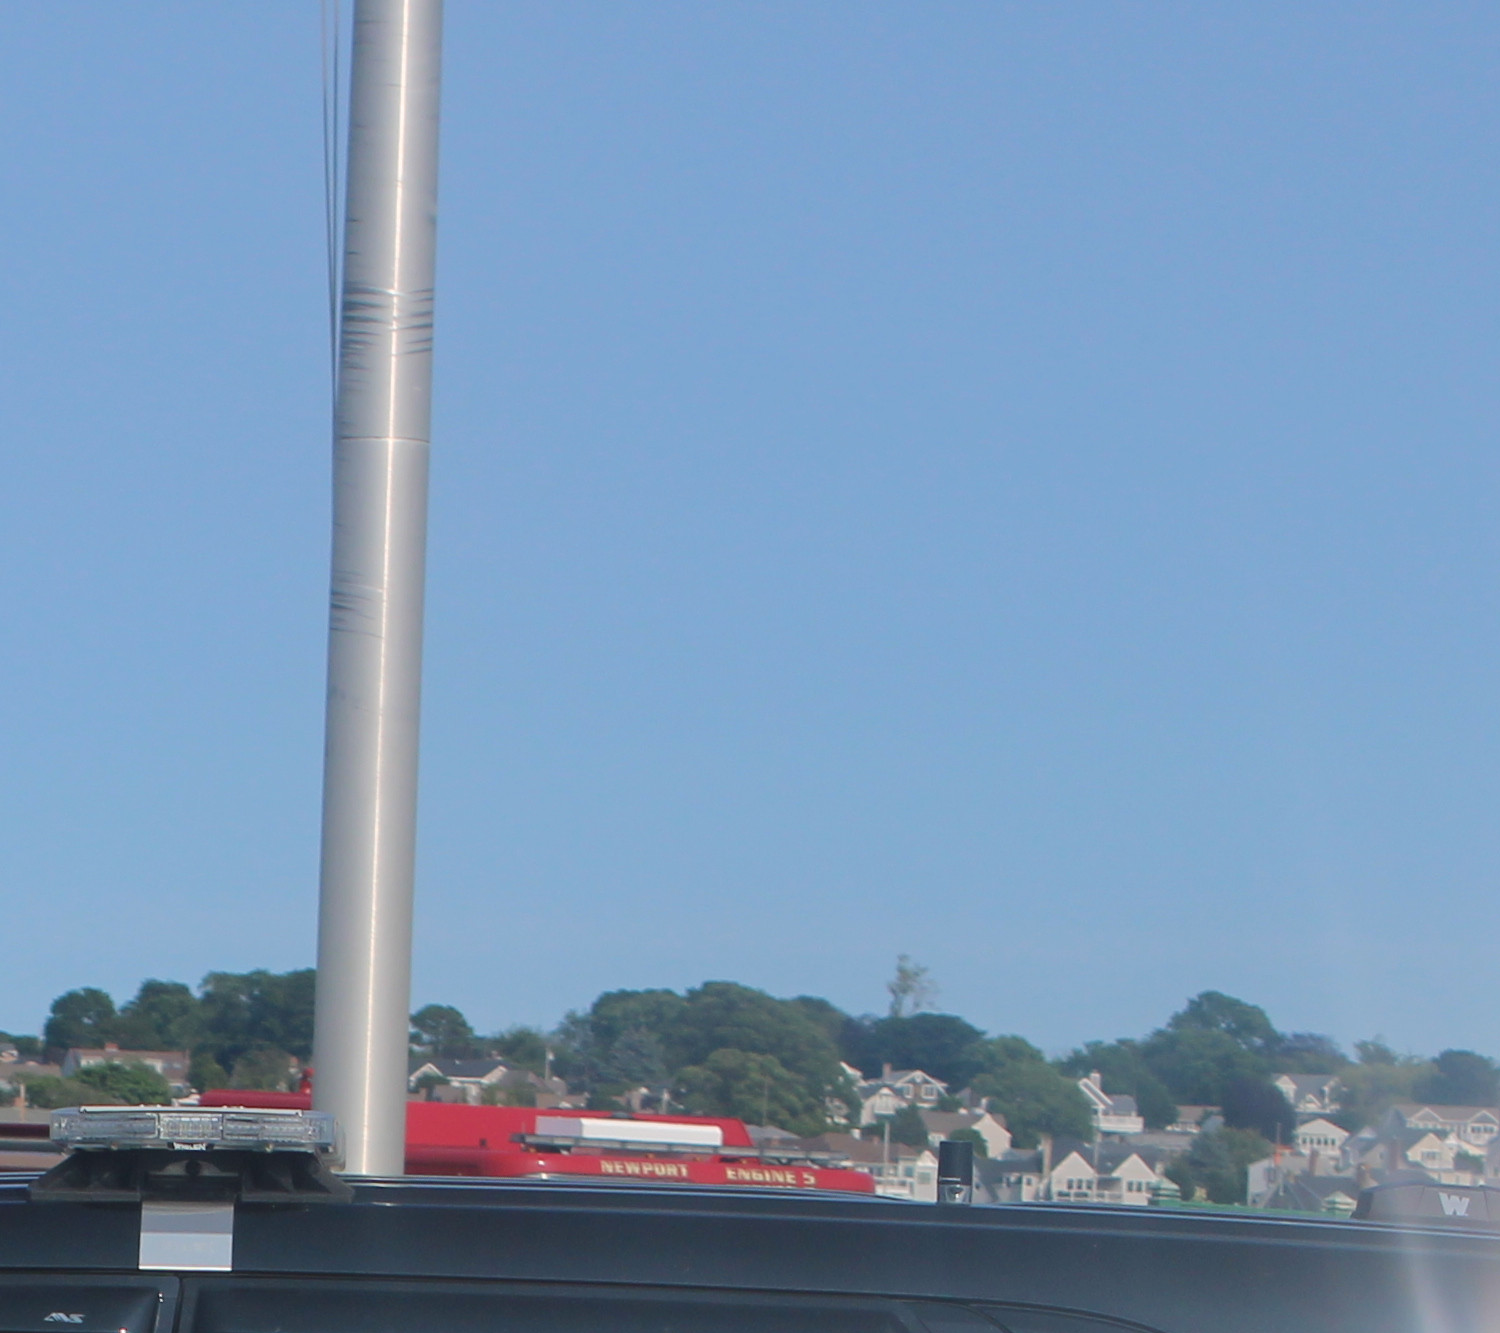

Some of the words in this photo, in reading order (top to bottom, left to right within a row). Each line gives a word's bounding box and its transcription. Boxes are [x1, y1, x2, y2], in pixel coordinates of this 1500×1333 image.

[600, 1159, 689, 1177] NEWPORT
[725, 1167, 797, 1185] ENGINE
[801, 1172, 817, 1185] 5
